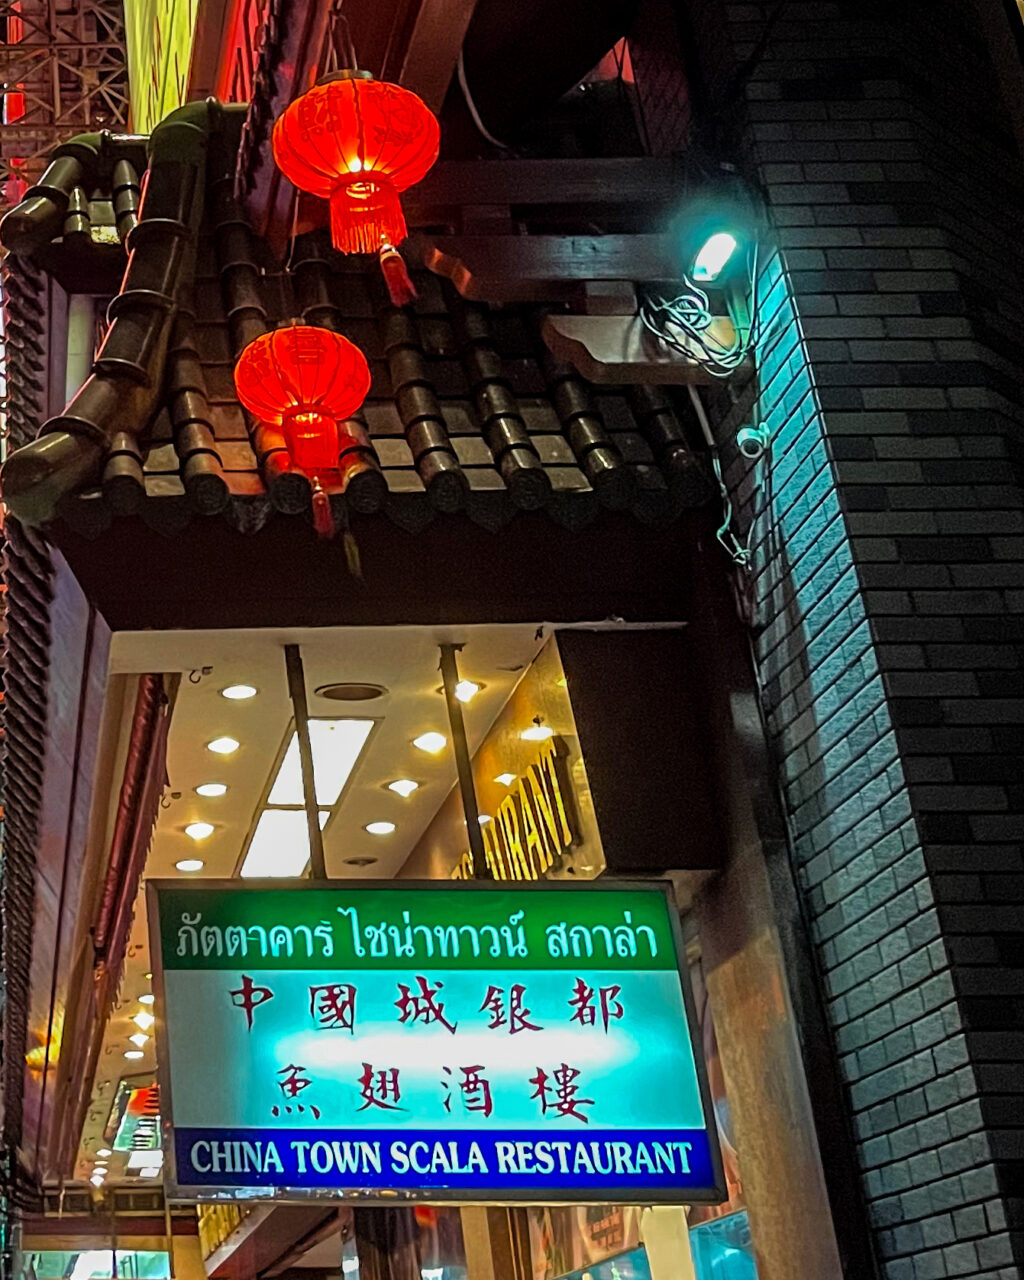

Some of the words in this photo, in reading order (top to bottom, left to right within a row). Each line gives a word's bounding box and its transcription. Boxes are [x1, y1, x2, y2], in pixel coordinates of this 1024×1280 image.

[175, 911, 334, 960] ภัตตาคาร
[337, 907, 528, 959] ไชน่าทาวน์
[545, 911, 658, 957] สกาล่า
[228, 974, 625, 1035] 中國城銀都
[271, 1062, 596, 1124] 魚翅酒樓
[190, 1139, 284, 1174] CHINA
[291, 1140, 382, 1174] TOWN
[390, 1140, 487, 1174] SCALA
[495, 1140, 693, 1174] RESTAURANT
